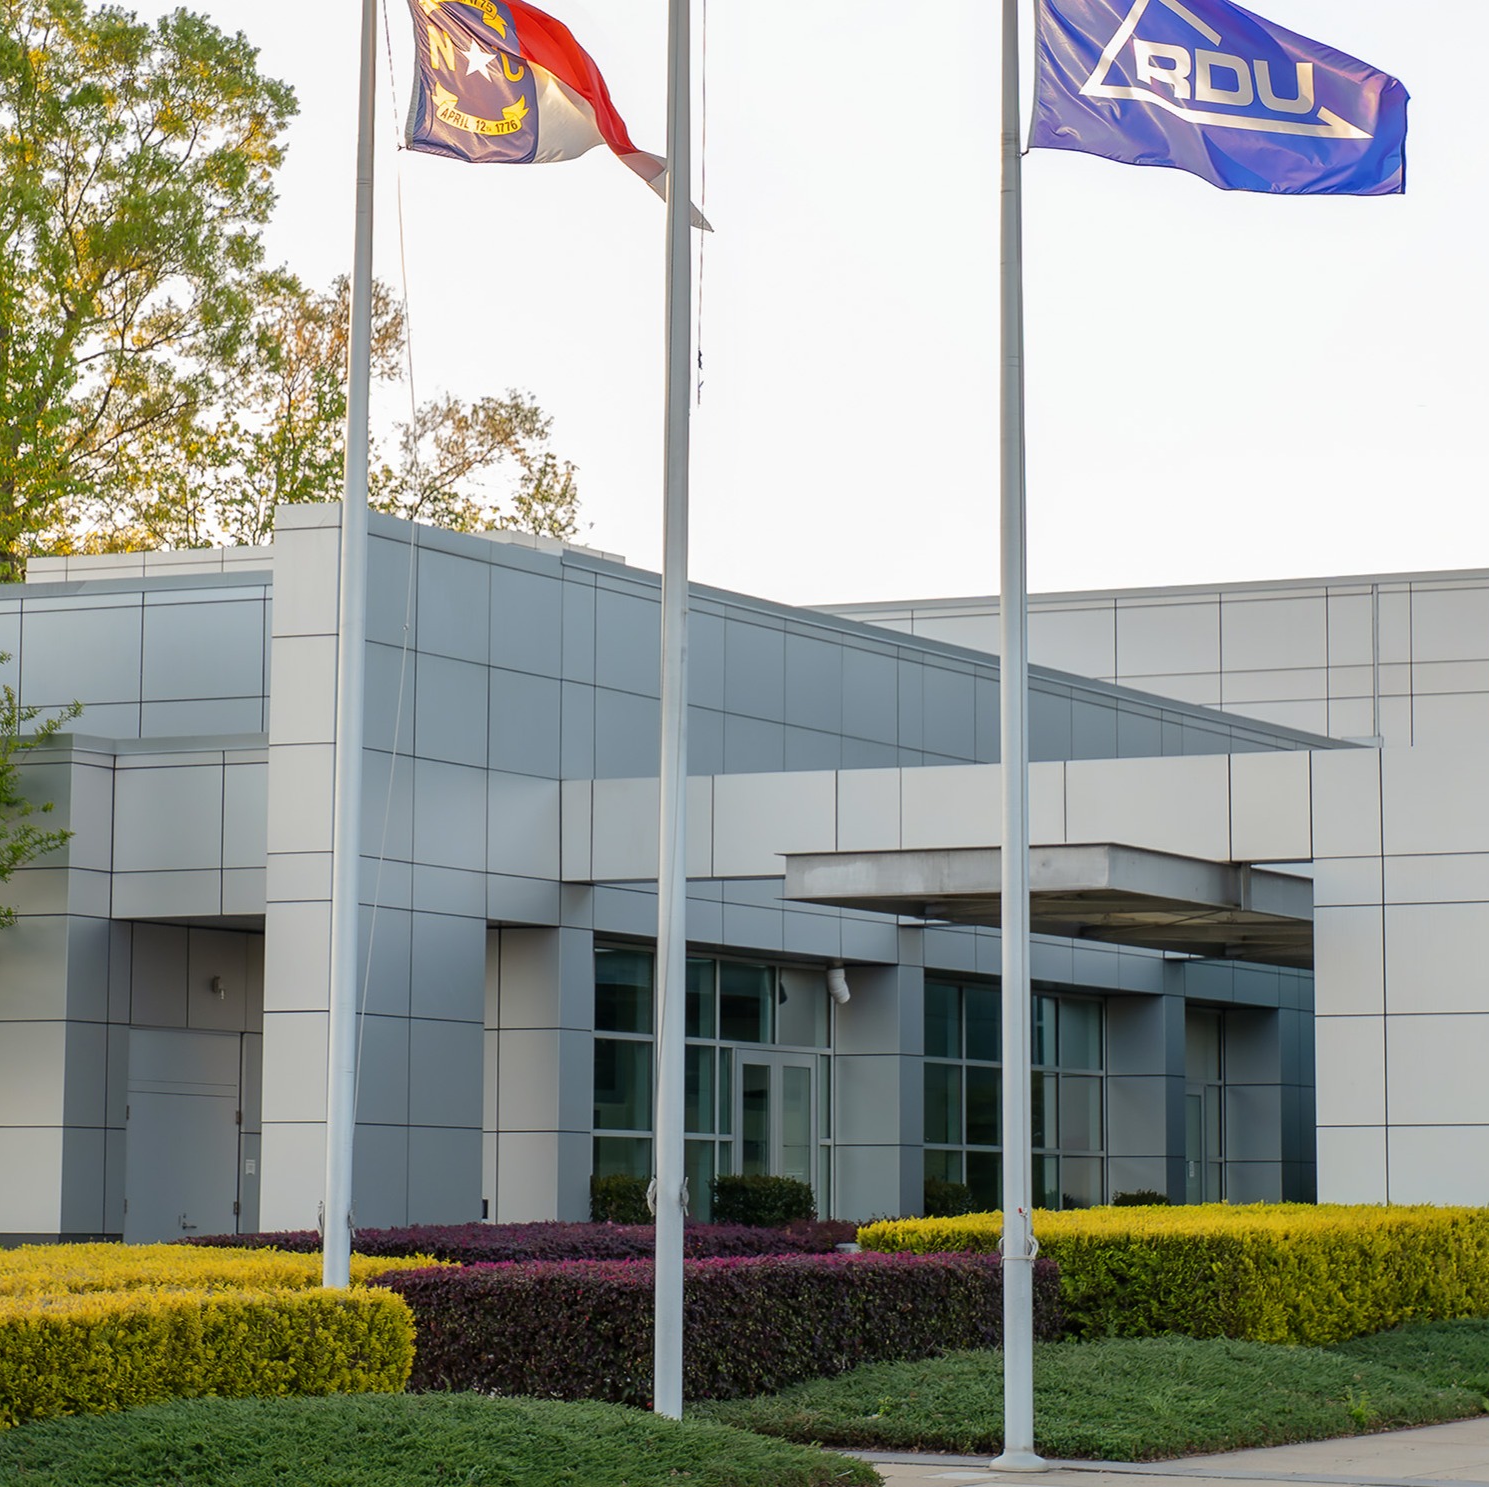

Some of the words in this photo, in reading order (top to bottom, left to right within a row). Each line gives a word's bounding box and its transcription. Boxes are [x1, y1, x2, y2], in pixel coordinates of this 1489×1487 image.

[426, 24, 456, 71] N
[1133, 39, 1315, 115] RDU
[440, 107, 470, 129] APRIL
[495, 119, 518, 133] 1776
